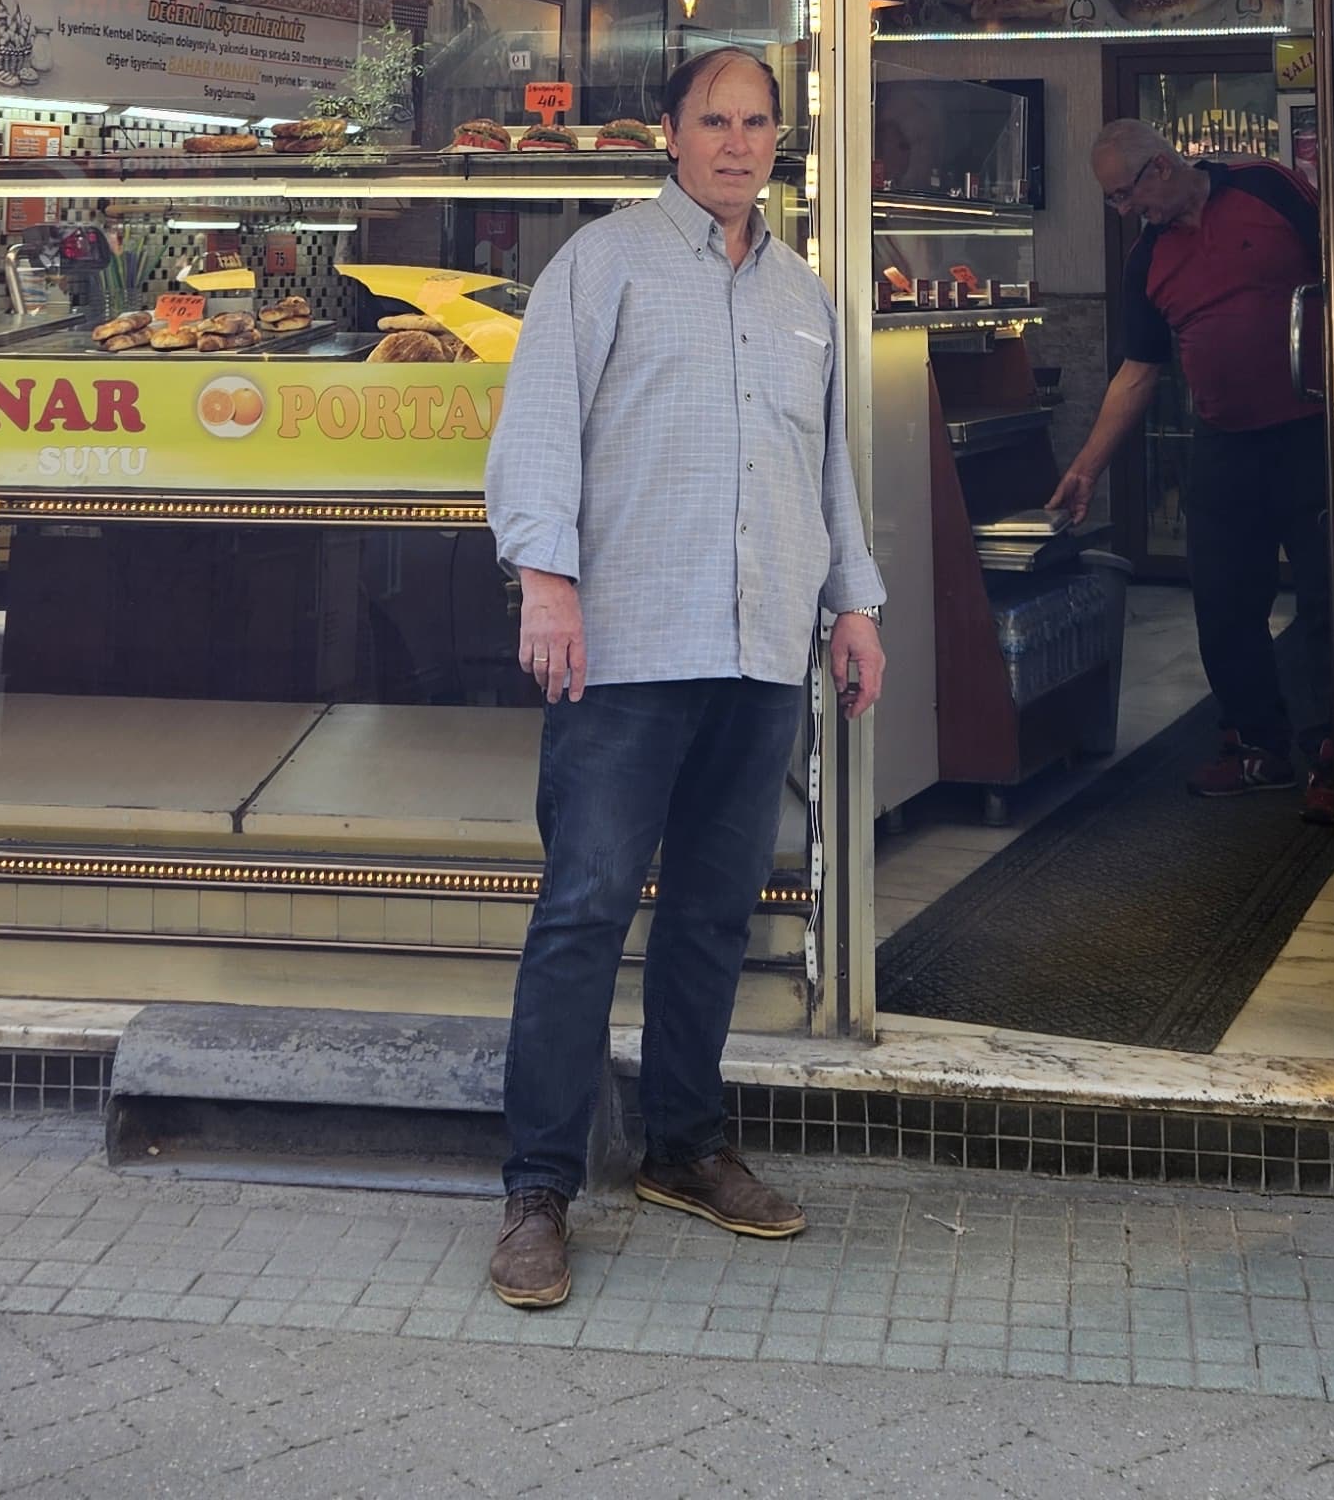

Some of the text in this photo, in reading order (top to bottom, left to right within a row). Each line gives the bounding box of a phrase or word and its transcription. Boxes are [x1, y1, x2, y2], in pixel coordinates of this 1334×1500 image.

[148, 0, 204, 28] DEĞERLİ
[67, 22, 101, 37] yerimiz
[103, 26, 134, 41] Kentsel
[291, 51, 300, 62] 50
[37, 446, 148, 477] SUYU
